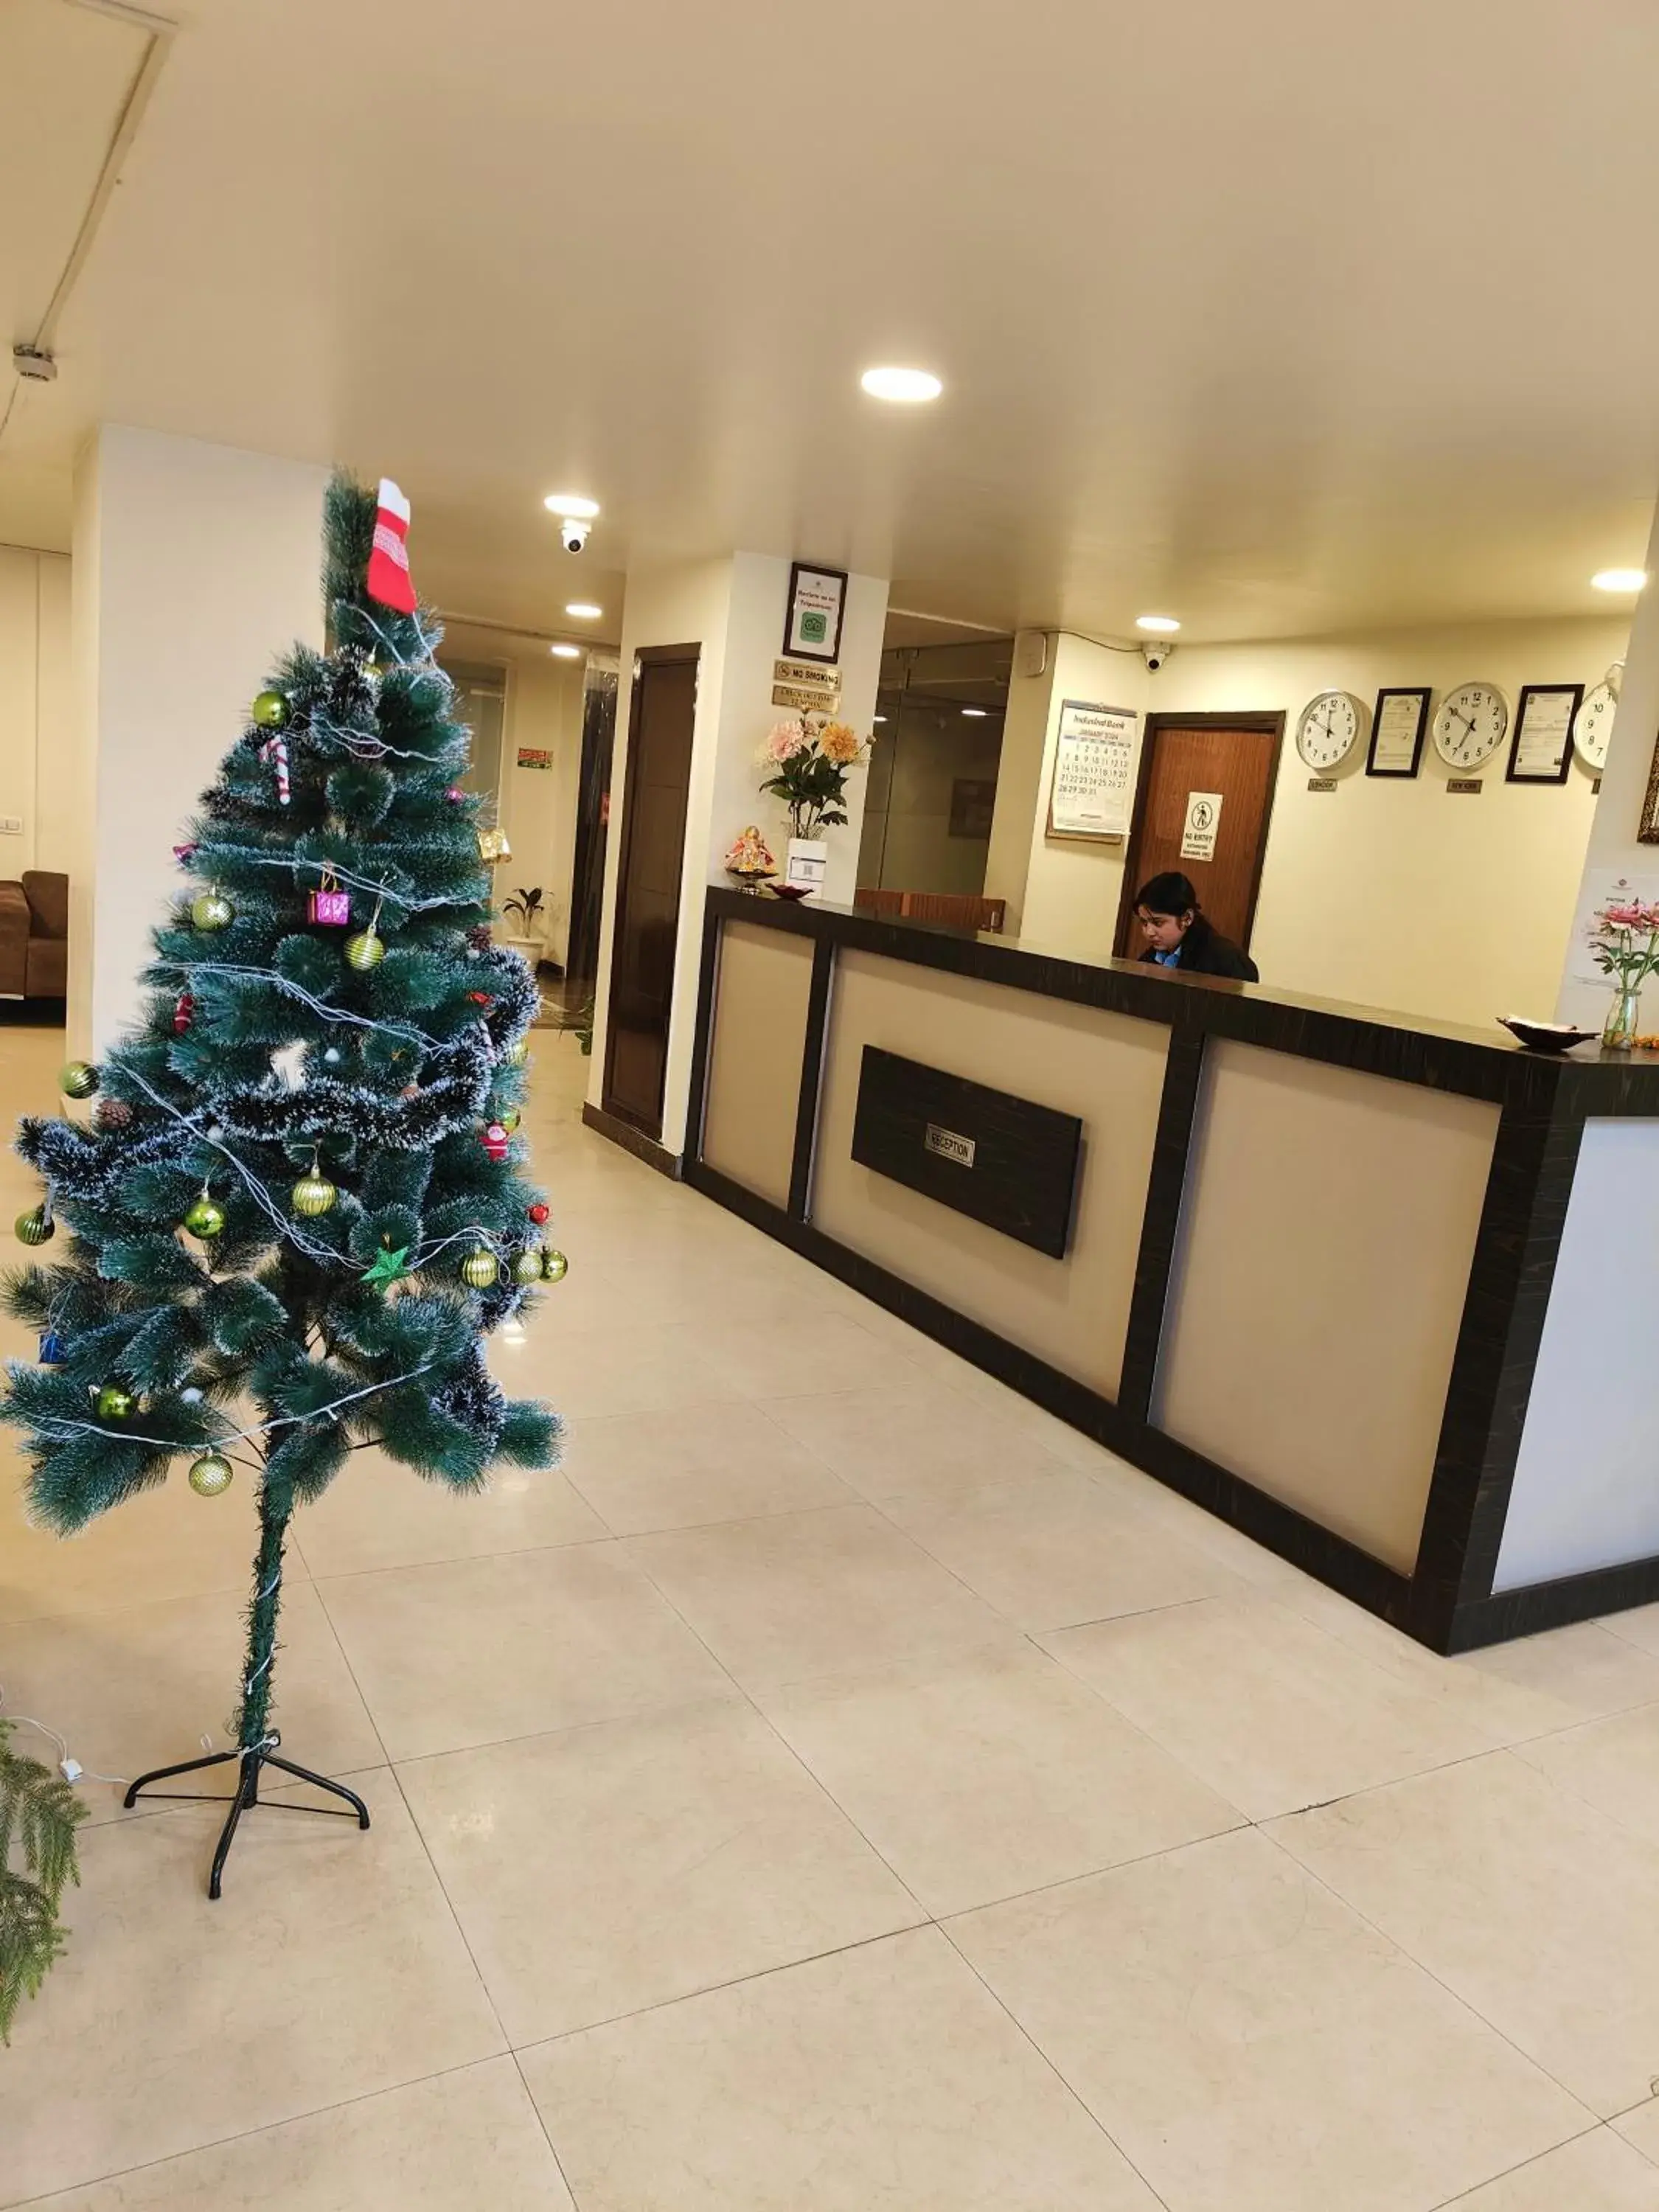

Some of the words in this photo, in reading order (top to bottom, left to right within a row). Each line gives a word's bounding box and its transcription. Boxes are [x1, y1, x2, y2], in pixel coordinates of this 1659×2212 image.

[1473, 692, 1481, 701] 12
[1486, 695, 1491, 705] 1
[1461, 697, 1468, 706] 11
[1492, 707, 1499, 716] 2
[1594, 703, 1604, 713] 10
[1444, 722, 1450, 731] 9
[1493, 723, 1499, 731] 3
[1587, 720, 1594, 729] 9
[1445, 737, 1450, 745] 8
[1487, 737, 1493, 745] 4
[1587, 735, 1595, 745] 8
[1452, 747, 1458, 756] 7
[1463, 752, 1470, 760] 6
[1475, 748, 1482, 757] 5
[1597, 747, 1603, 757] 7
